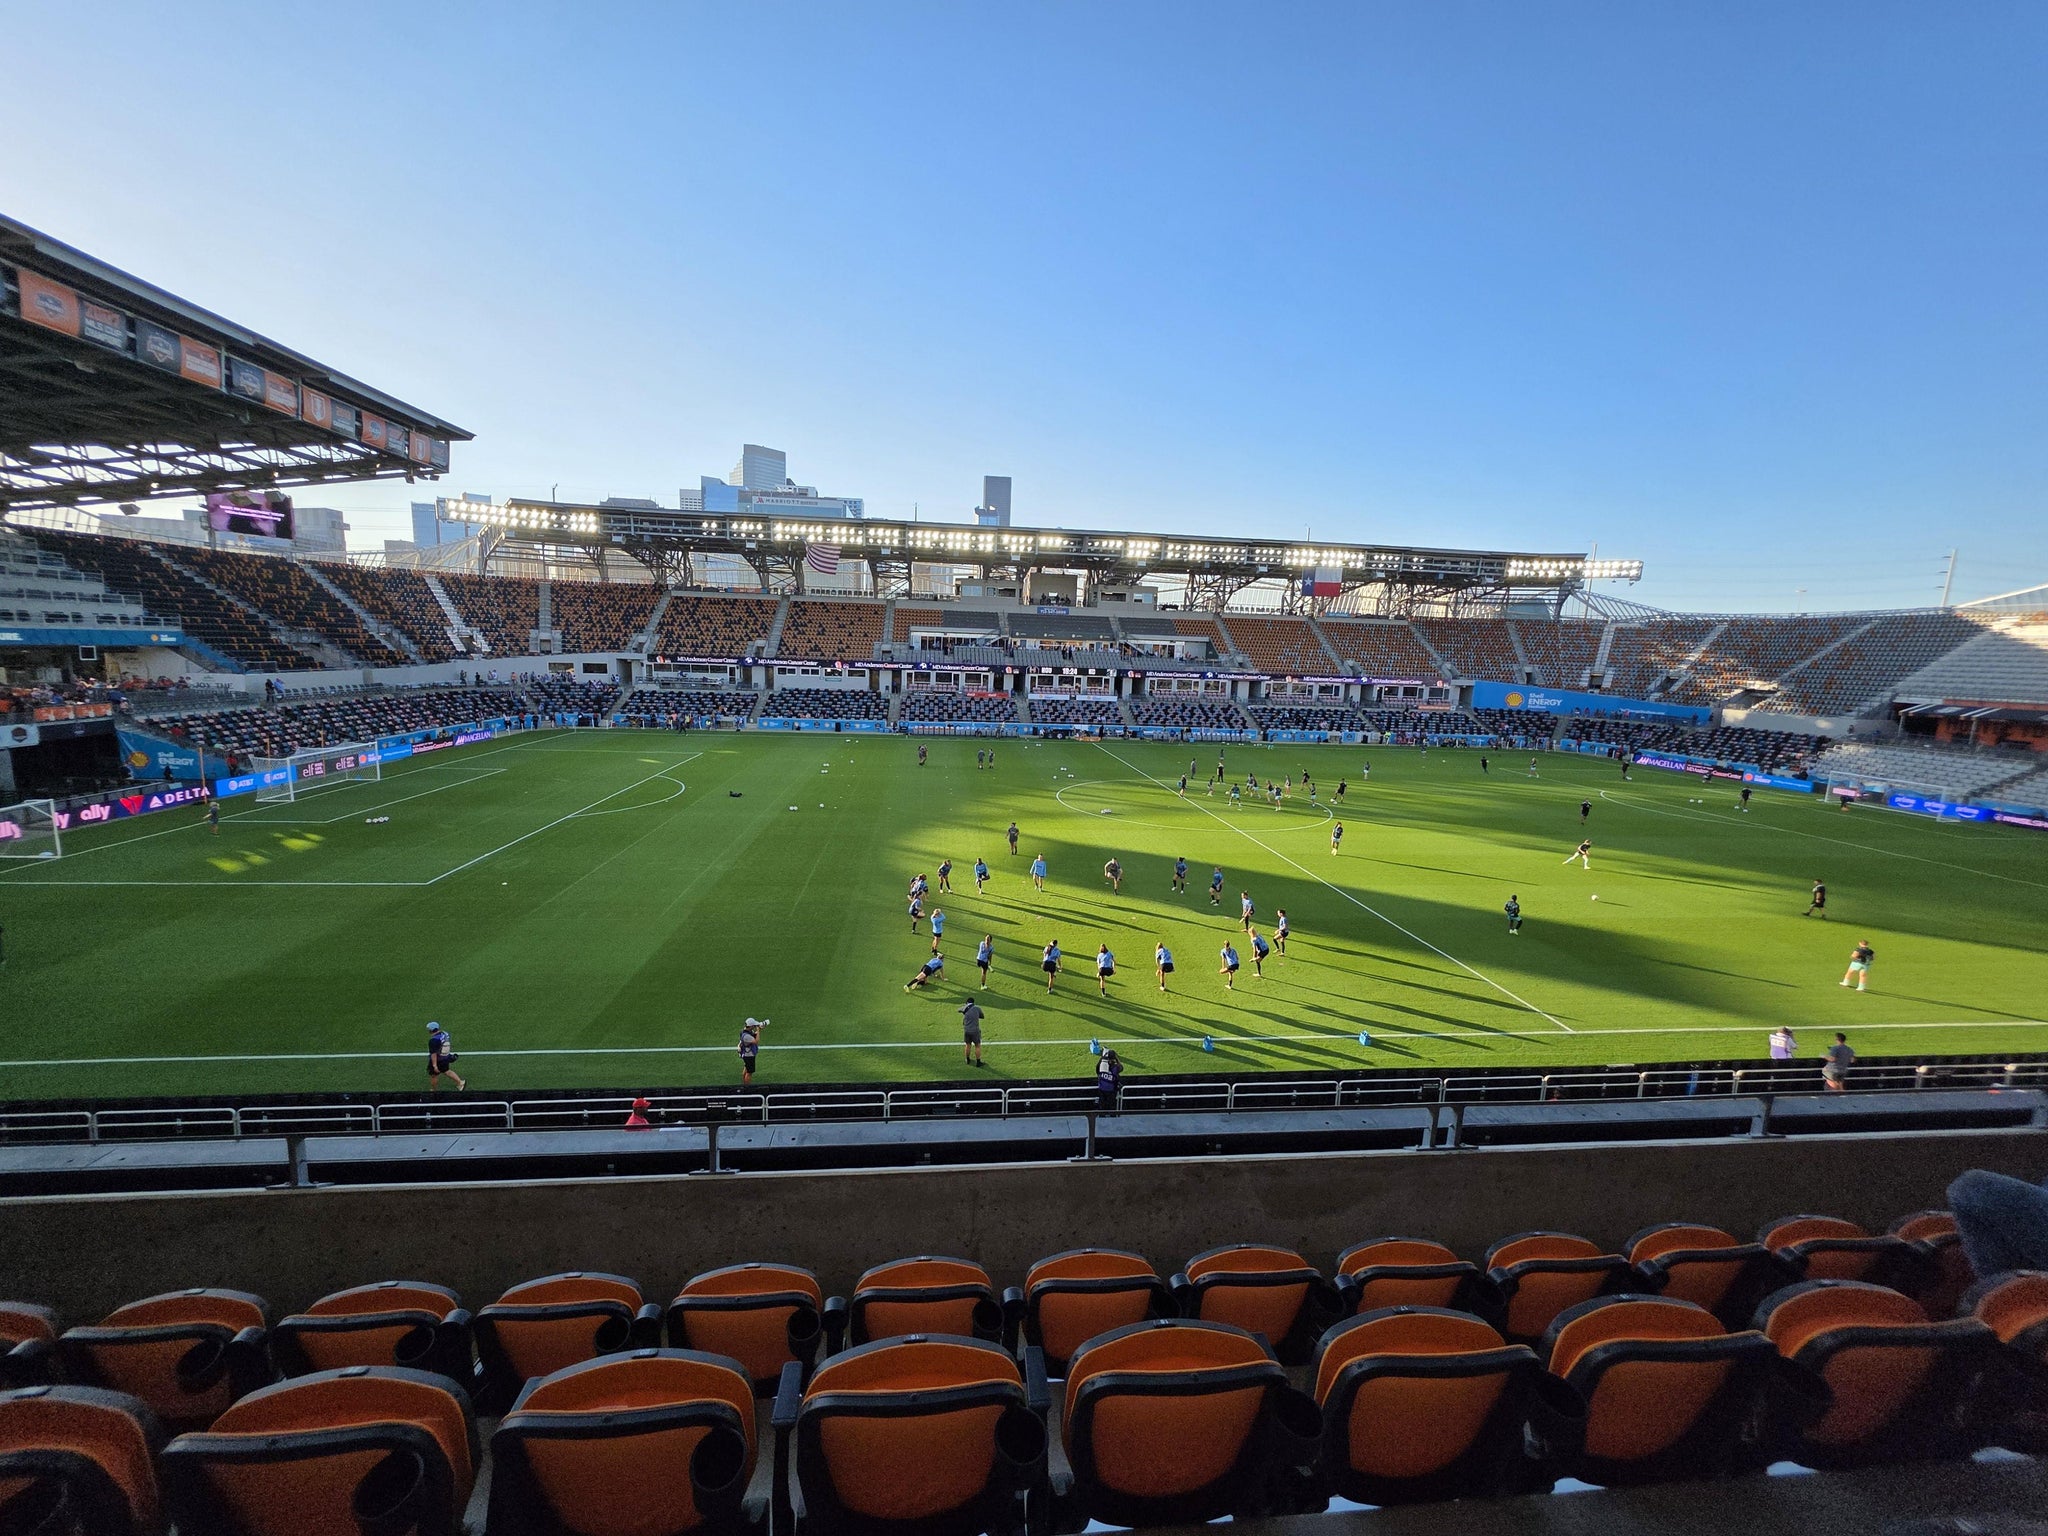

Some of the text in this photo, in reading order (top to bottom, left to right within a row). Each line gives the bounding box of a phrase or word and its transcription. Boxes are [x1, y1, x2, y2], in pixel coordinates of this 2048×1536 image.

[1528, 698, 1563, 707] ENERGY
[464, 731, 492, 743] MAGELLAN
[158, 757, 195, 766] ENERGY
[1648, 757, 1685, 770] MAGELLAN
[302, 763, 314, 777] elf
[164, 786, 211, 804] DELTA
[80, 804, 110, 820] ally
